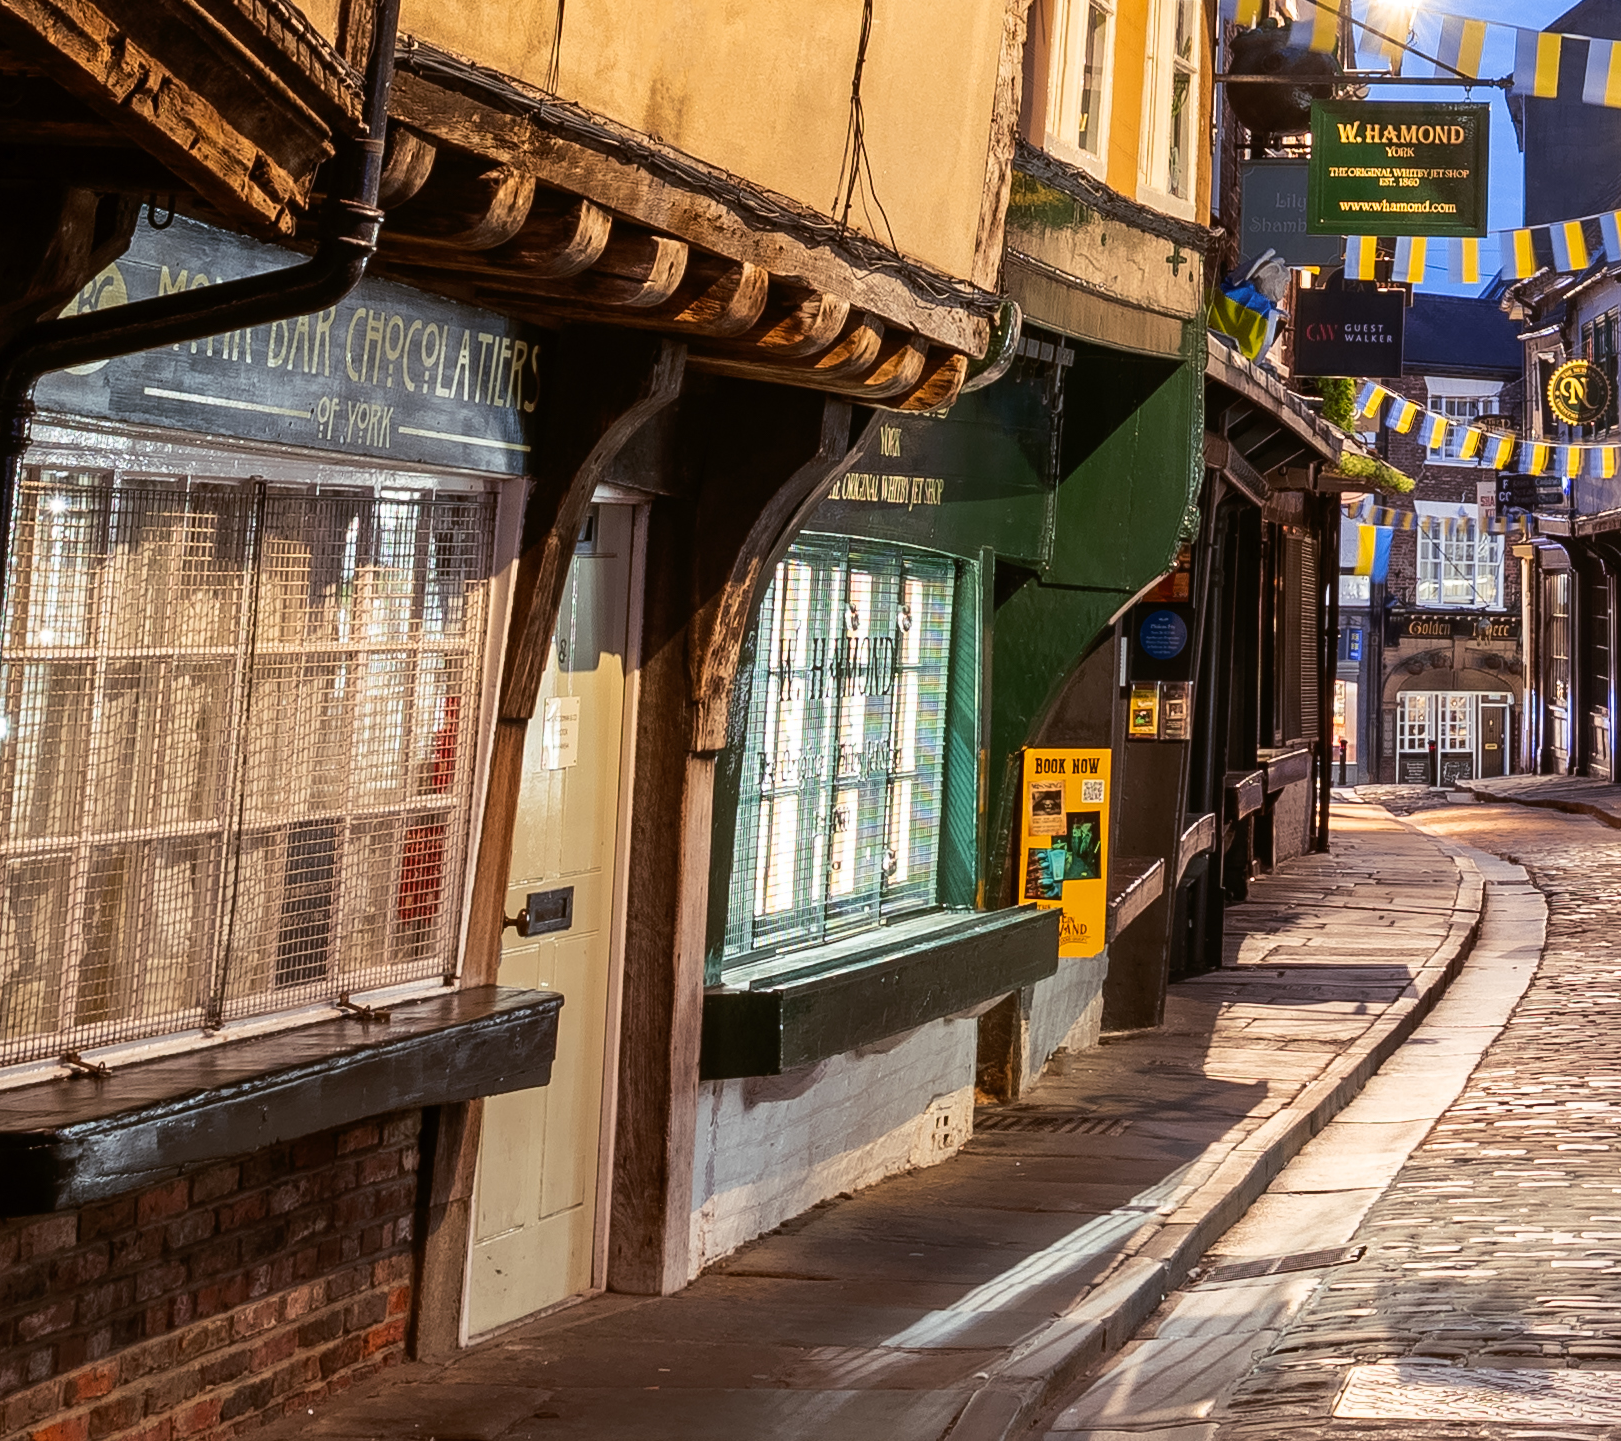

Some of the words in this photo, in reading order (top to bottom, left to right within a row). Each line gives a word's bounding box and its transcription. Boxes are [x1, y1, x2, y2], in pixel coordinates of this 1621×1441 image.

[1365, 124, 1465, 144] HAMOND
[1385, 145, 1415, 158] YORK
[1329, 167, 1348, 177] THE
[1347, 167, 1392, 178] ORIGINAL
[1392, 168, 1429, 178] WHITBY
[1429, 169, 1444, 179] JET
[1444, 169, 1469, 179] SHOP
[1275, 192, 1308, 213] Lily
[1339, 199, 1457, 214] www.whamond.com
[1249, 216, 1308, 233] Shamb
[1344, 323, 1384, 333] GUEST
[1344, 334, 1393, 344] WALKER
[344, 306, 543, 414] CHOCOLATIERS
[317, 395, 340, 441] OF
[347, 399, 395, 449] YORK
[841, 473, 880, 502] ORIGINAL
[881, 475, 912, 504] WHITBY
[908, 477, 925, 512] JET
[924, 478, 945, 506] SHOP
[1409, 620, 1451, 635] Golden
[1034, 758, 1067, 775] BOOK
[1071, 758, 1101, 774] NOW
